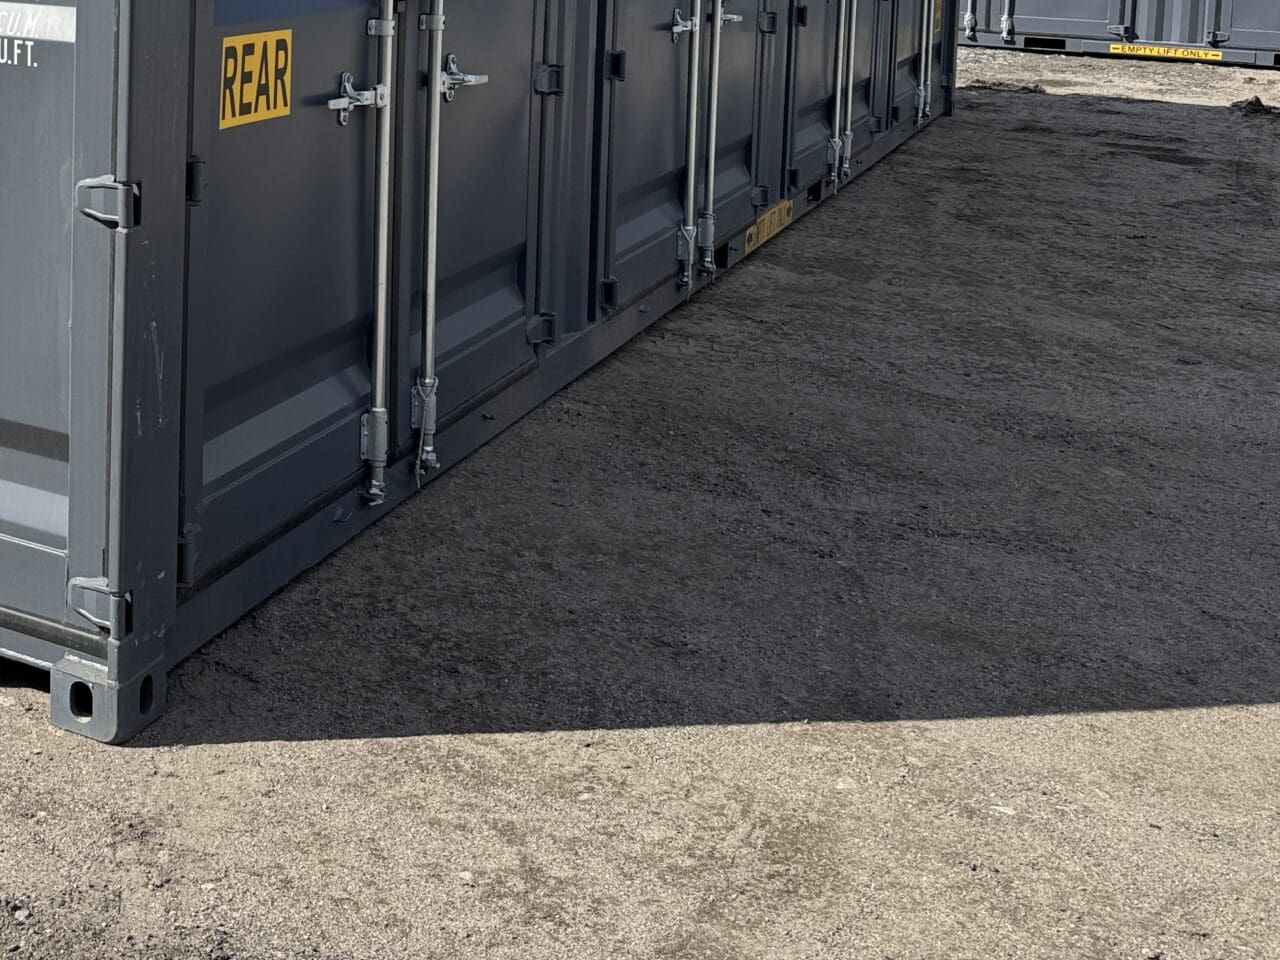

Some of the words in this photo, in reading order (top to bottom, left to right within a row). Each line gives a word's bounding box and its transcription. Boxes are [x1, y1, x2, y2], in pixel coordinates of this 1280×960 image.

[1121, 45, 1155, 54] EMPTY
[1157, 48, 1179, 56] LIFT
[1182, 50, 1210, 58] ONLY
[221, 38, 288, 121] REAR
